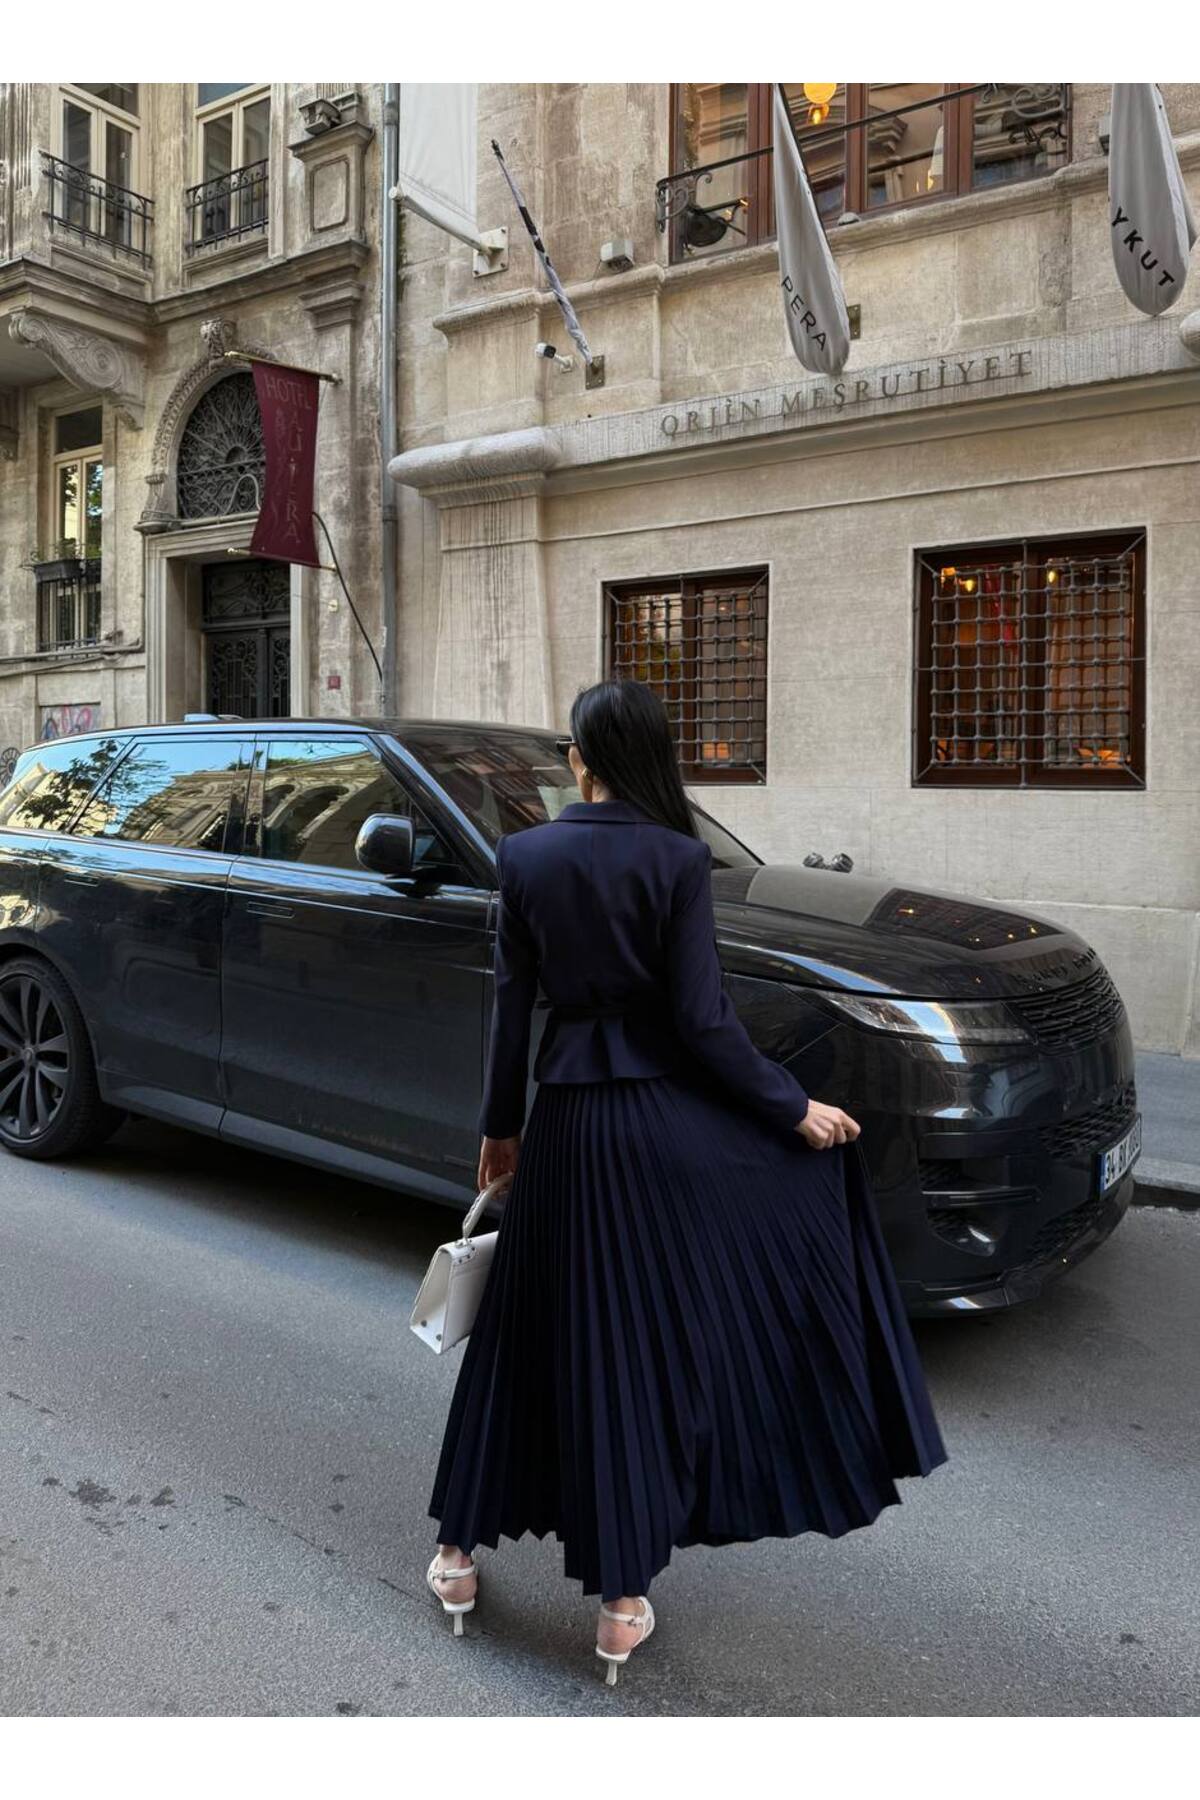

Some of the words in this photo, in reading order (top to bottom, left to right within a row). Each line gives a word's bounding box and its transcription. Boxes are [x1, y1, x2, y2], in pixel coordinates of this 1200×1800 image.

[1109, 205, 1175, 287] YKUT
[781, 275, 827, 352] PERA
[265, 376, 312, 410] HOTEL
[780, 350, 1033, 416] MEŞRUTİYET
